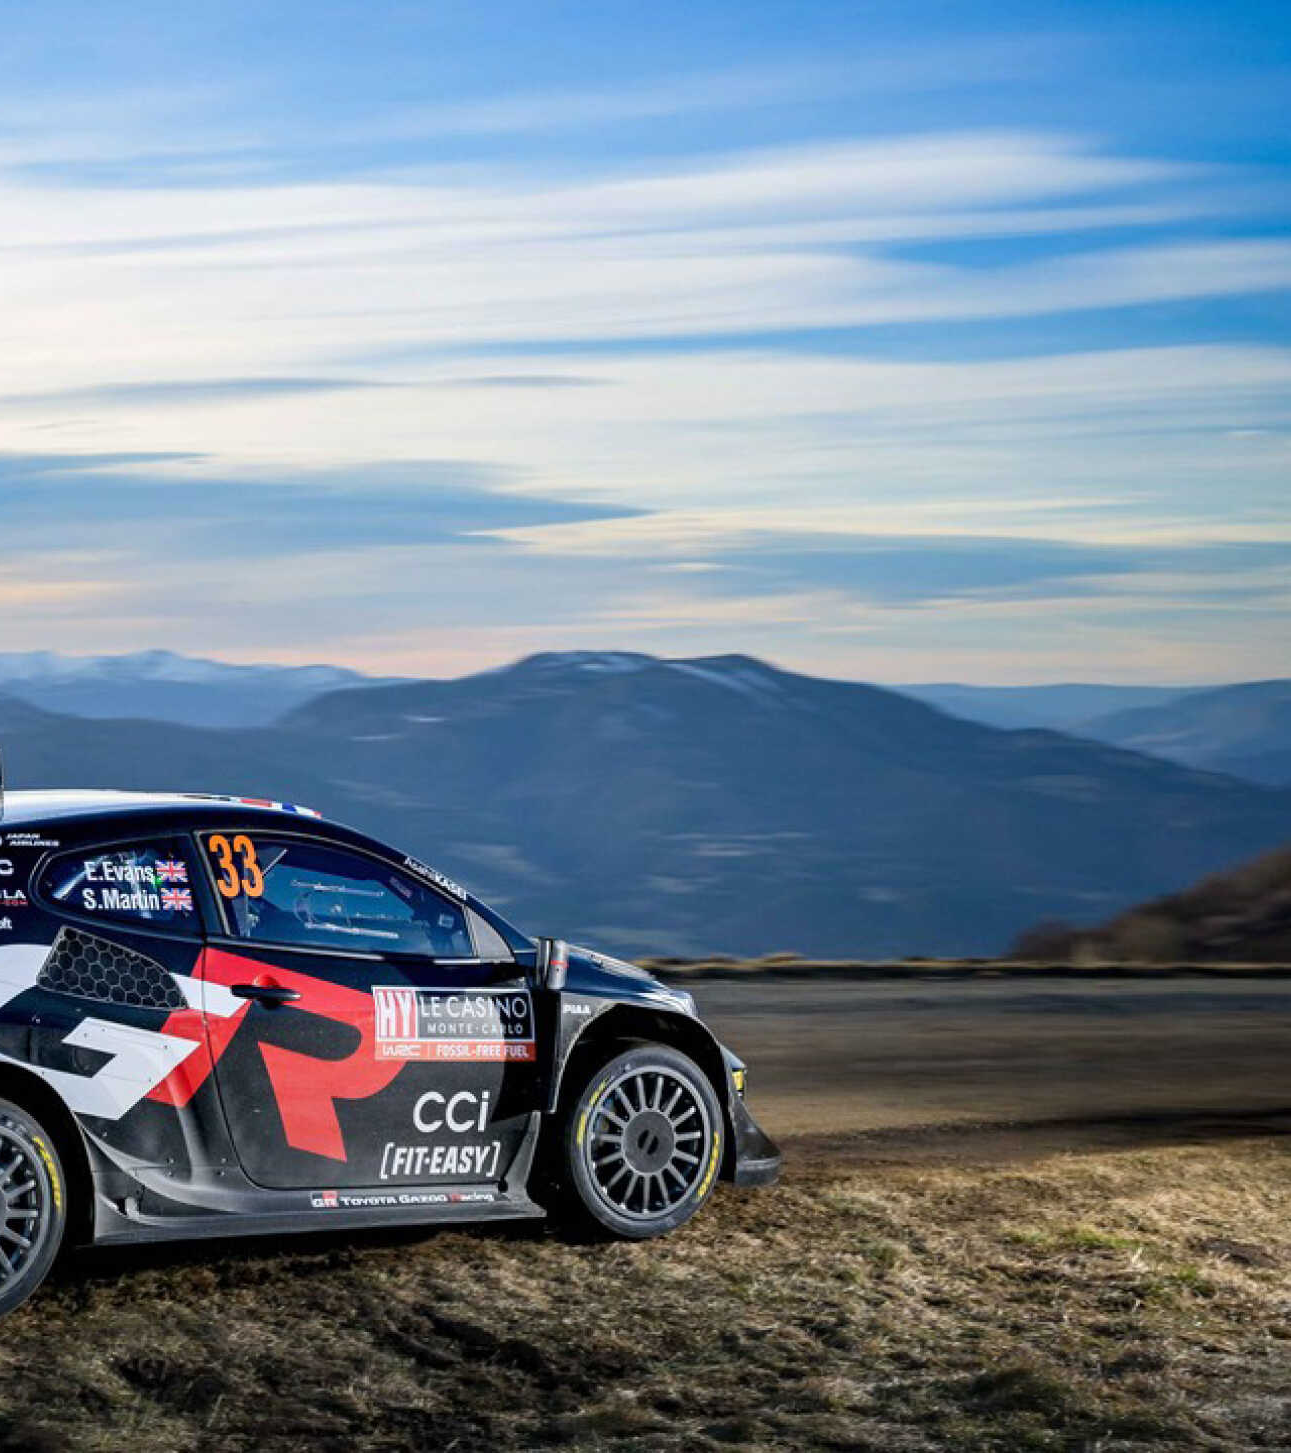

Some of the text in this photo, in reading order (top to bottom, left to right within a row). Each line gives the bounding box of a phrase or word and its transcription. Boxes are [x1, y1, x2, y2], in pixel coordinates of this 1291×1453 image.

[84, 861, 155, 883] E.Evans
[209, 834, 264, 898] 33
[82, 888, 160, 911] S.Martin
[419, 996, 528, 1018] LE CASINO
[436, 1044, 529, 1057] FOSSIL-FREE FUEL
[340, 1196, 397, 1206] TOYOTA
